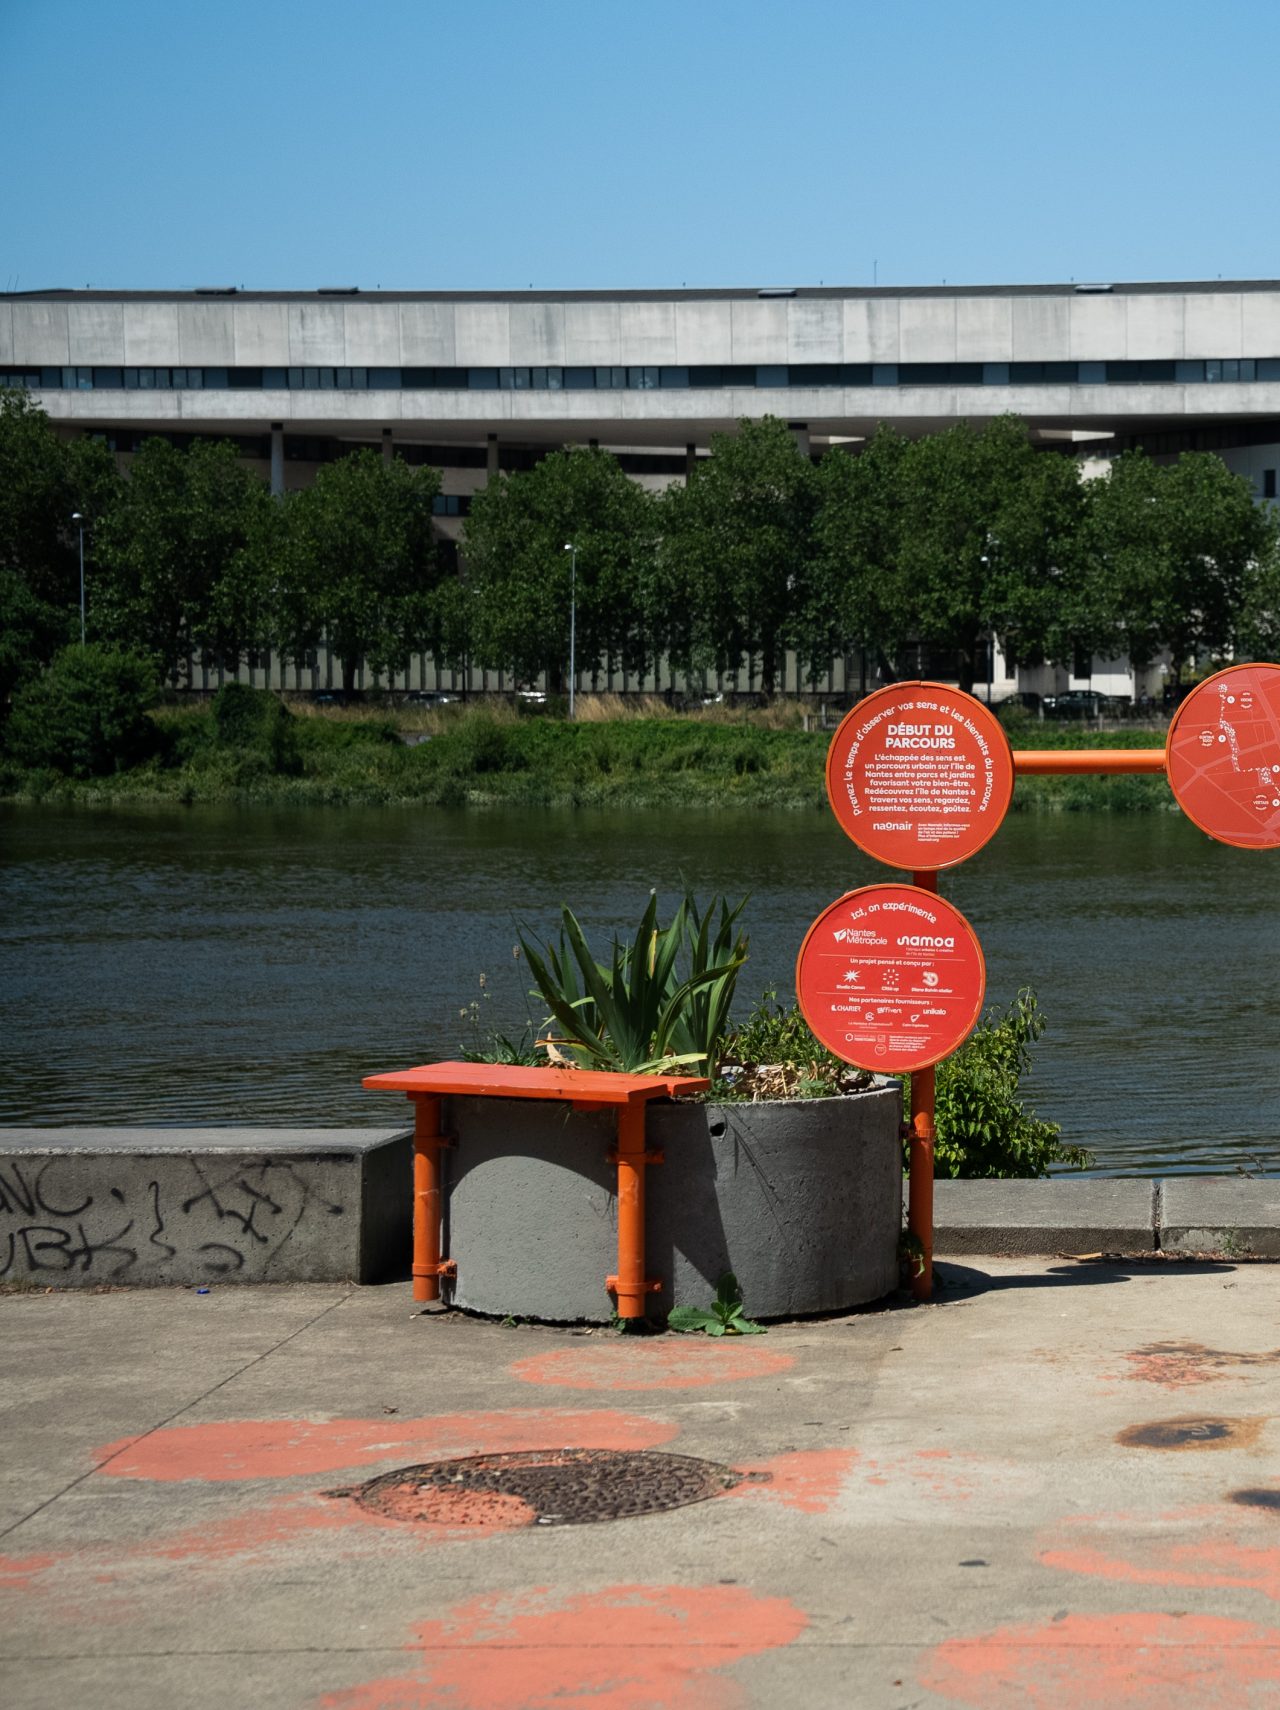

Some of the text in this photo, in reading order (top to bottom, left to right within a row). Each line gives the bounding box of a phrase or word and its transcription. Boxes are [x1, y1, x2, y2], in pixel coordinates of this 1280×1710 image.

[897, 702, 914, 711] vos
[916, 702, 937, 711] sens
[940, 706, 950, 714] et
[951, 708, 964, 722] les
[856, 707, 895, 741] d'observer
[888, 722, 953, 735] DÉBUT DU
[885, 737, 955, 749] PARCOURS
[964, 718, 989, 756] bienfaits
[845, 742, 860, 768] temps
[875, 754, 919, 762] L'échappée
[985, 758, 994, 769] du
[844, 771, 852, 780] le
[847, 783, 863, 816] Prenez
[868, 904, 880, 912] on
[882, 902, 936, 924] expérimente
[846, 928, 876, 937] Nantes
[846, 936, 888, 945] Métropole
[897, 936, 954, 948] samoa
